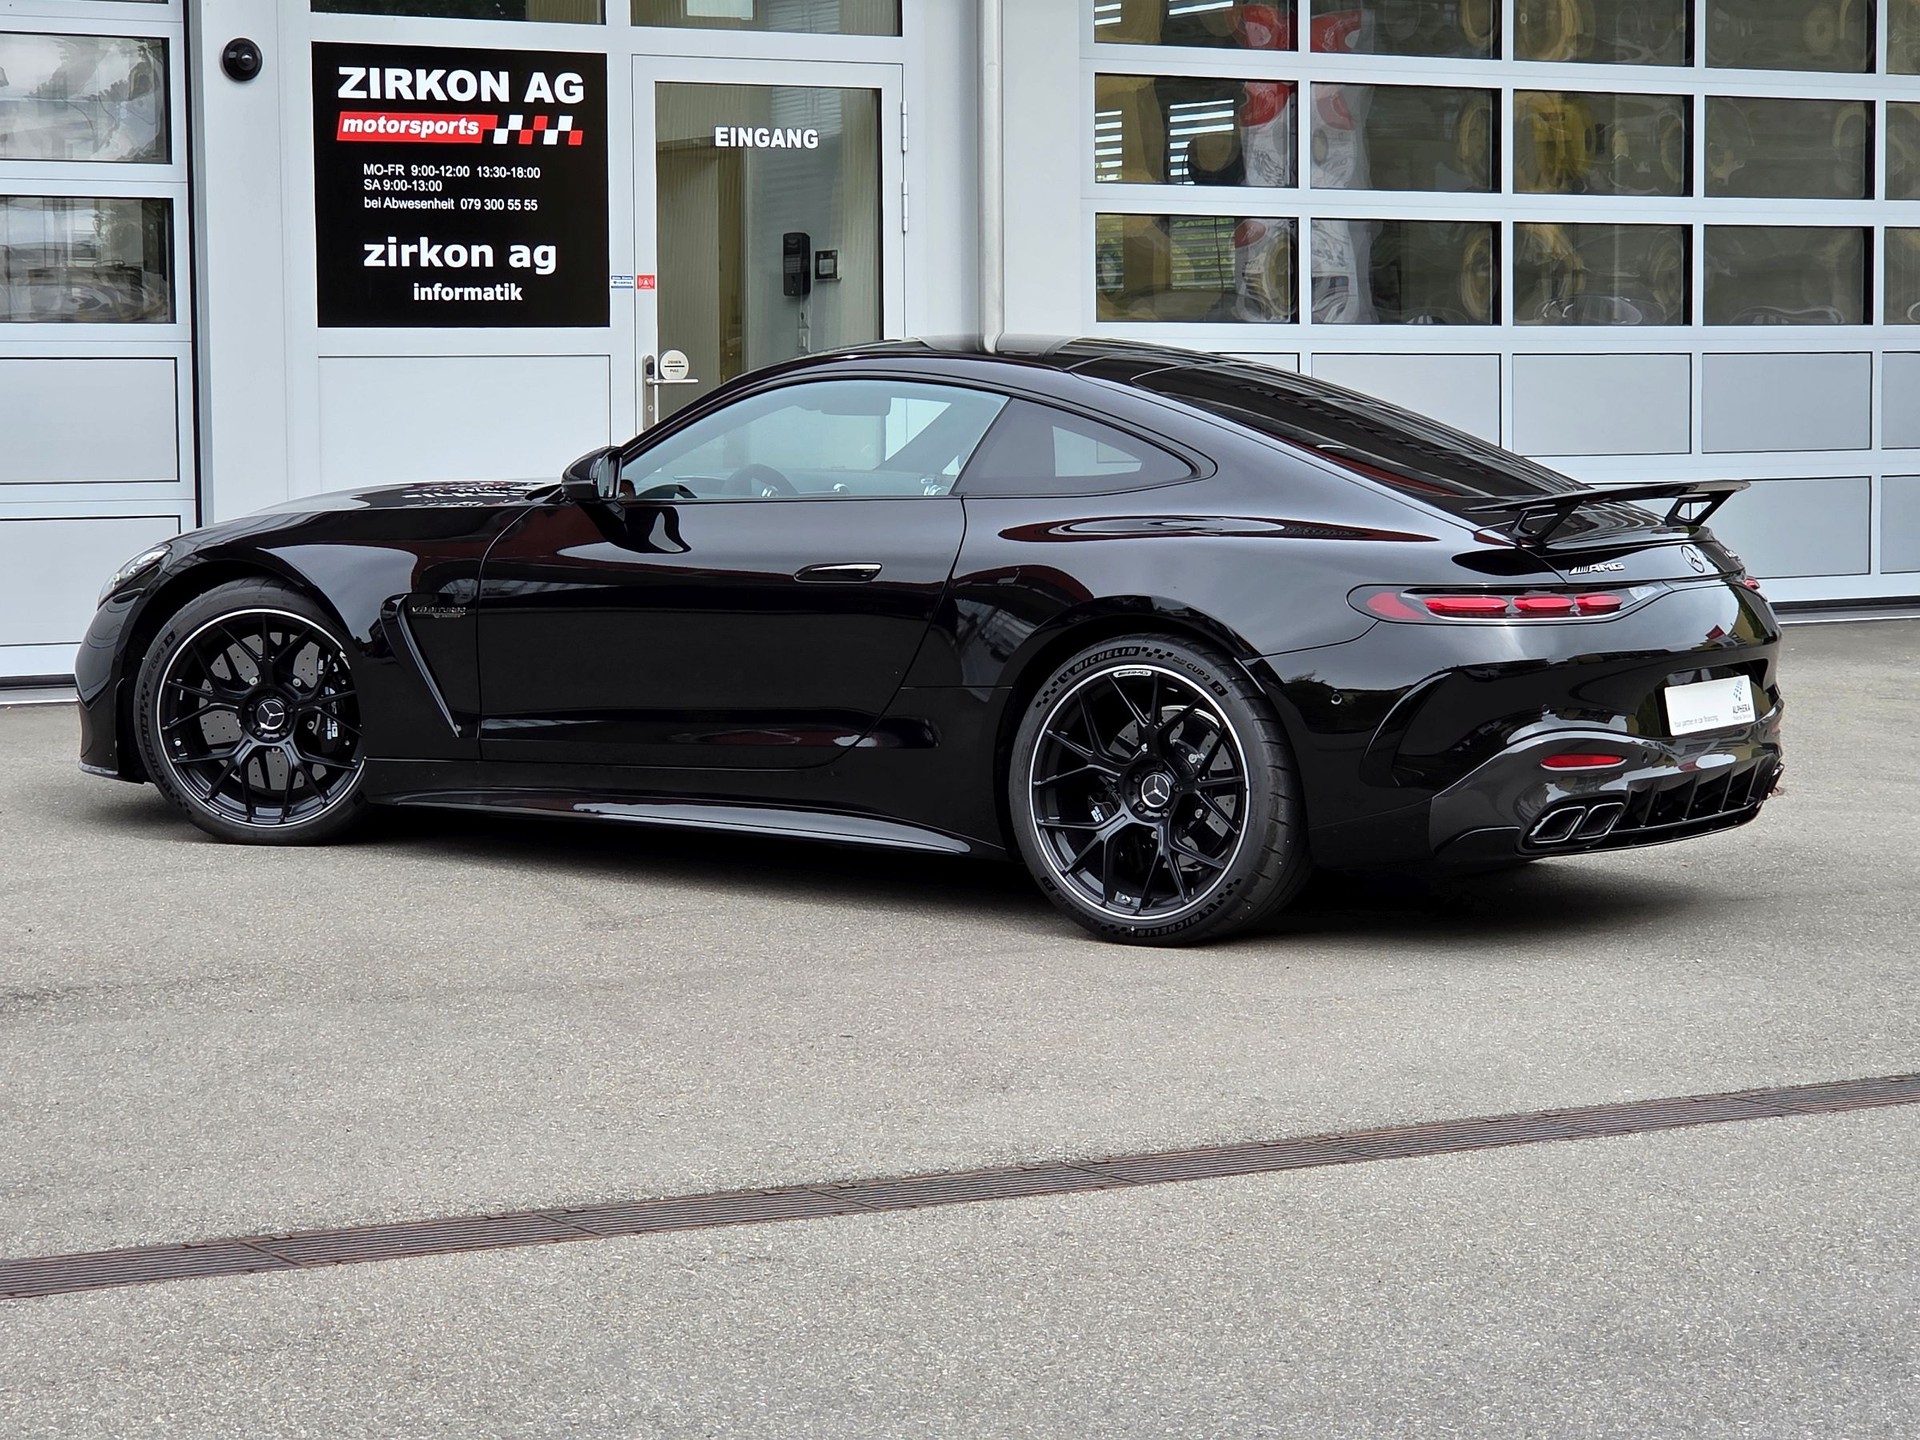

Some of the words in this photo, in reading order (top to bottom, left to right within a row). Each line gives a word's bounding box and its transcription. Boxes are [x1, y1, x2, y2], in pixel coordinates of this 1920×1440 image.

[338, 67, 509, 102] ZIRKON
[524, 72, 584, 103] AG
[343, 115, 479, 138] motorsports
[716, 127, 818, 148] EINGANG
[364, 164, 405, 175] MO-FR
[411, 165, 470, 177] 9:00-12:00
[477, 166, 540, 178] 13:30-18:00
[364, 179, 381, 190] SA
[383, 179, 442, 191] 9:00-13:00
[365, 197, 381, 208] bei
[383, 197, 454, 209] Abwesenheit
[461, 198, 481, 210] 079
[484, 199, 504, 210] 300
[508, 199, 521, 210] 55
[524, 199, 538, 210] 55
[364, 237, 493, 267] zirkon
[509, 245, 556, 274] ag
[414, 283, 522, 301] informatik
[1075, 647, 1137, 673] MICHELIN
[1137, 913, 1200, 937] MICHELIN
